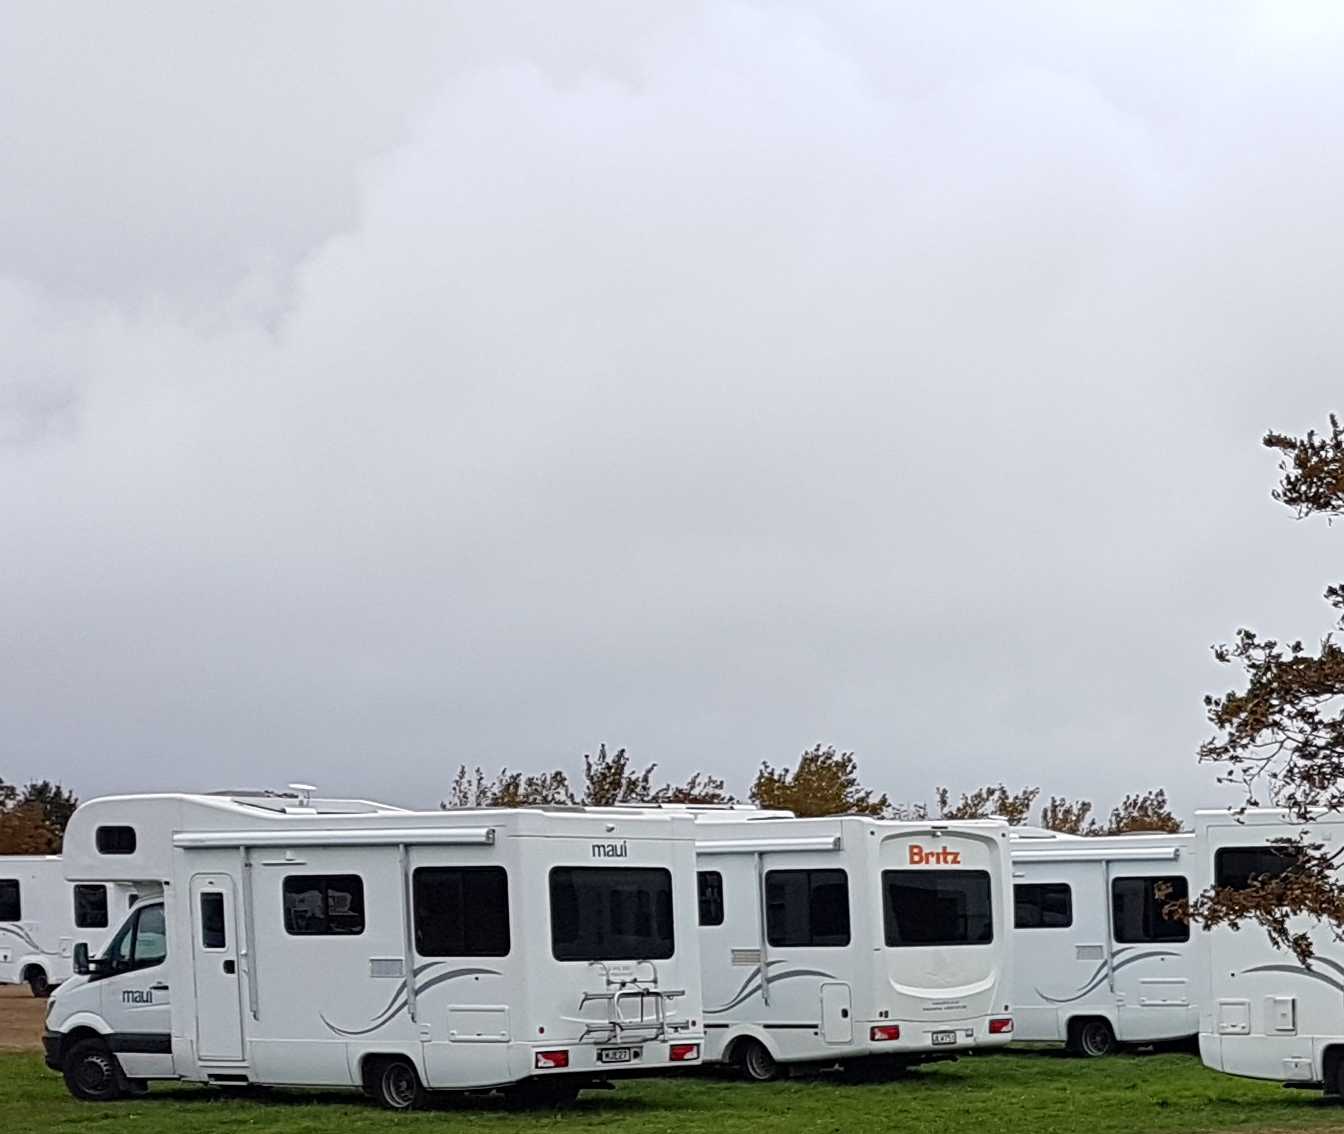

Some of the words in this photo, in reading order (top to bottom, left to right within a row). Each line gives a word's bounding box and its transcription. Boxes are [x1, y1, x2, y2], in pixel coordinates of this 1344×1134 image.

[591, 839, 628, 857] maui
[908, 844, 961, 864] Britz
[122, 990, 152, 1003] maui
